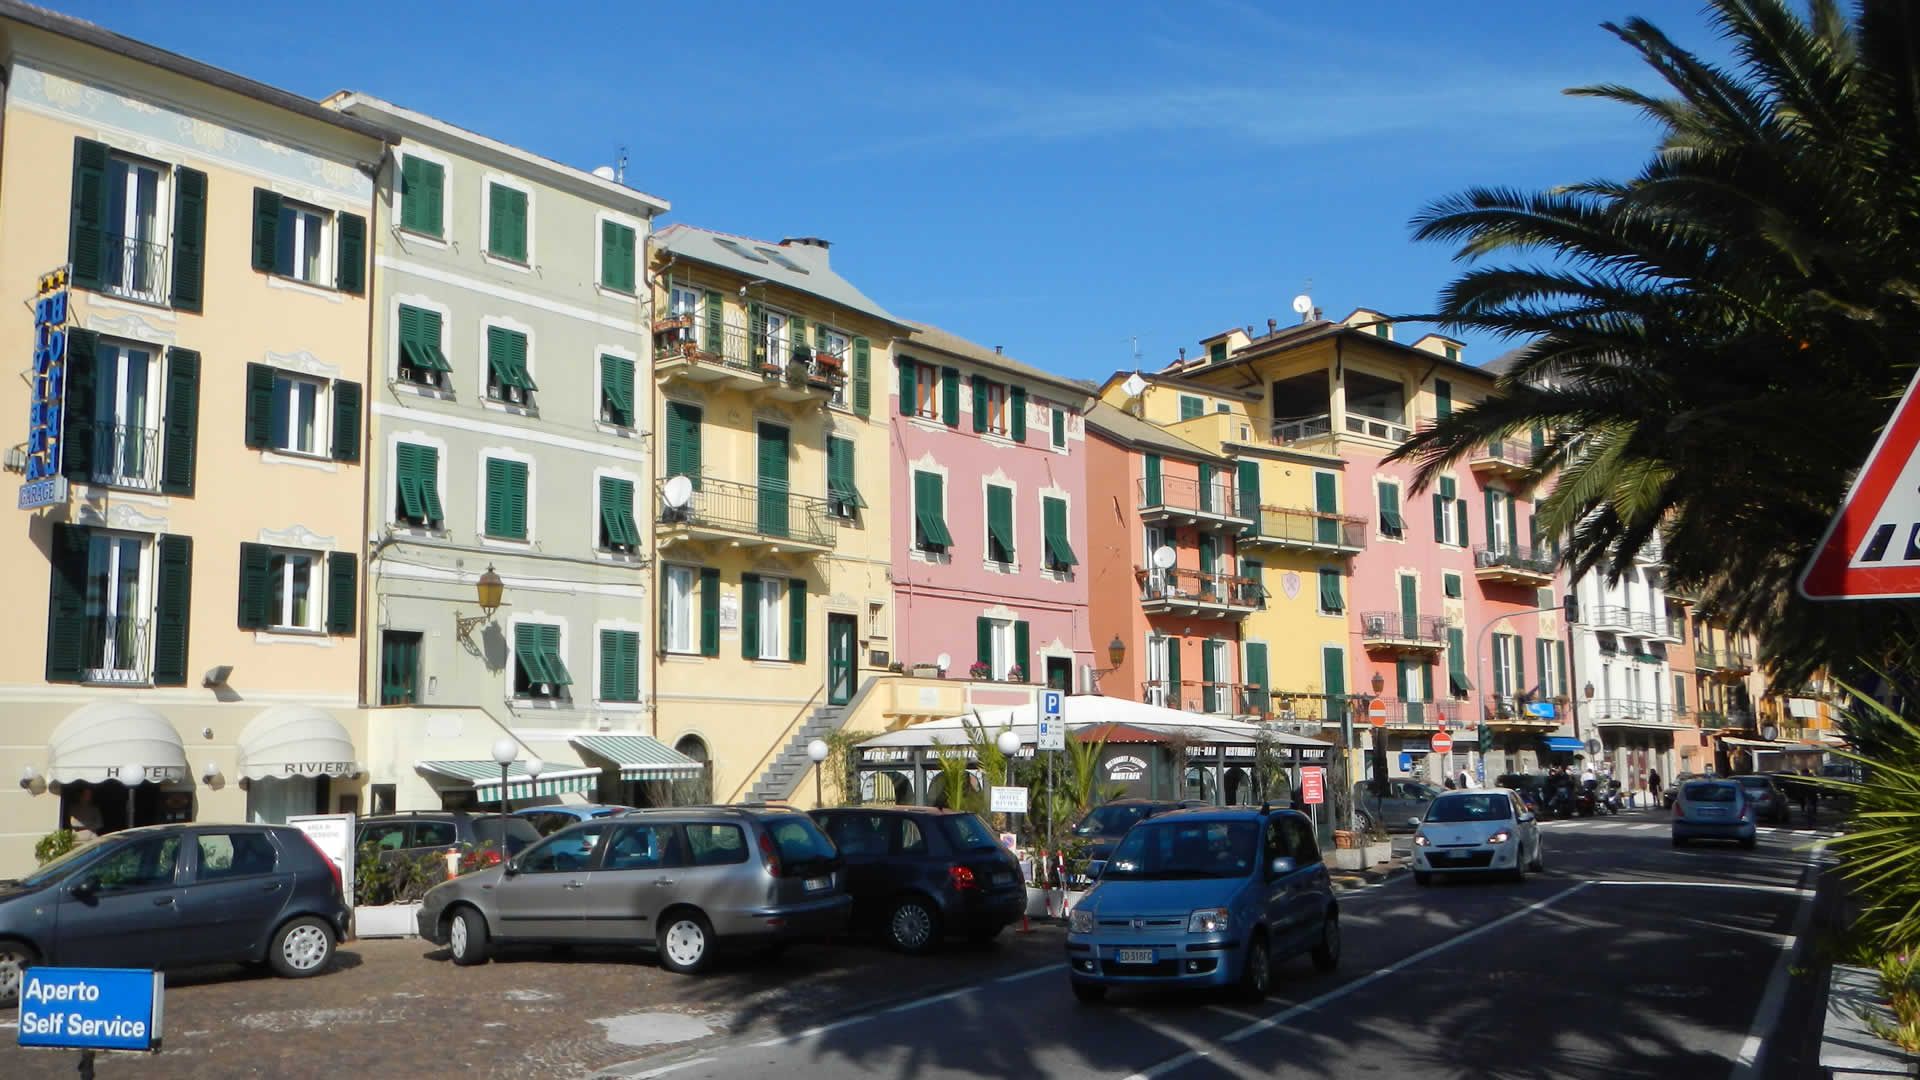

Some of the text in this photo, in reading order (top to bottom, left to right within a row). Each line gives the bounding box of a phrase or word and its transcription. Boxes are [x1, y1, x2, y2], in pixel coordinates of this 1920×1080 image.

[20, 481, 55, 506] GARAGE
[107, 766, 170, 779] HTEL
[284, 762, 352, 774] RIVIERA
[25, 978, 99, 1004] Aperto
[22, 1012, 146, 1037] Self Service
